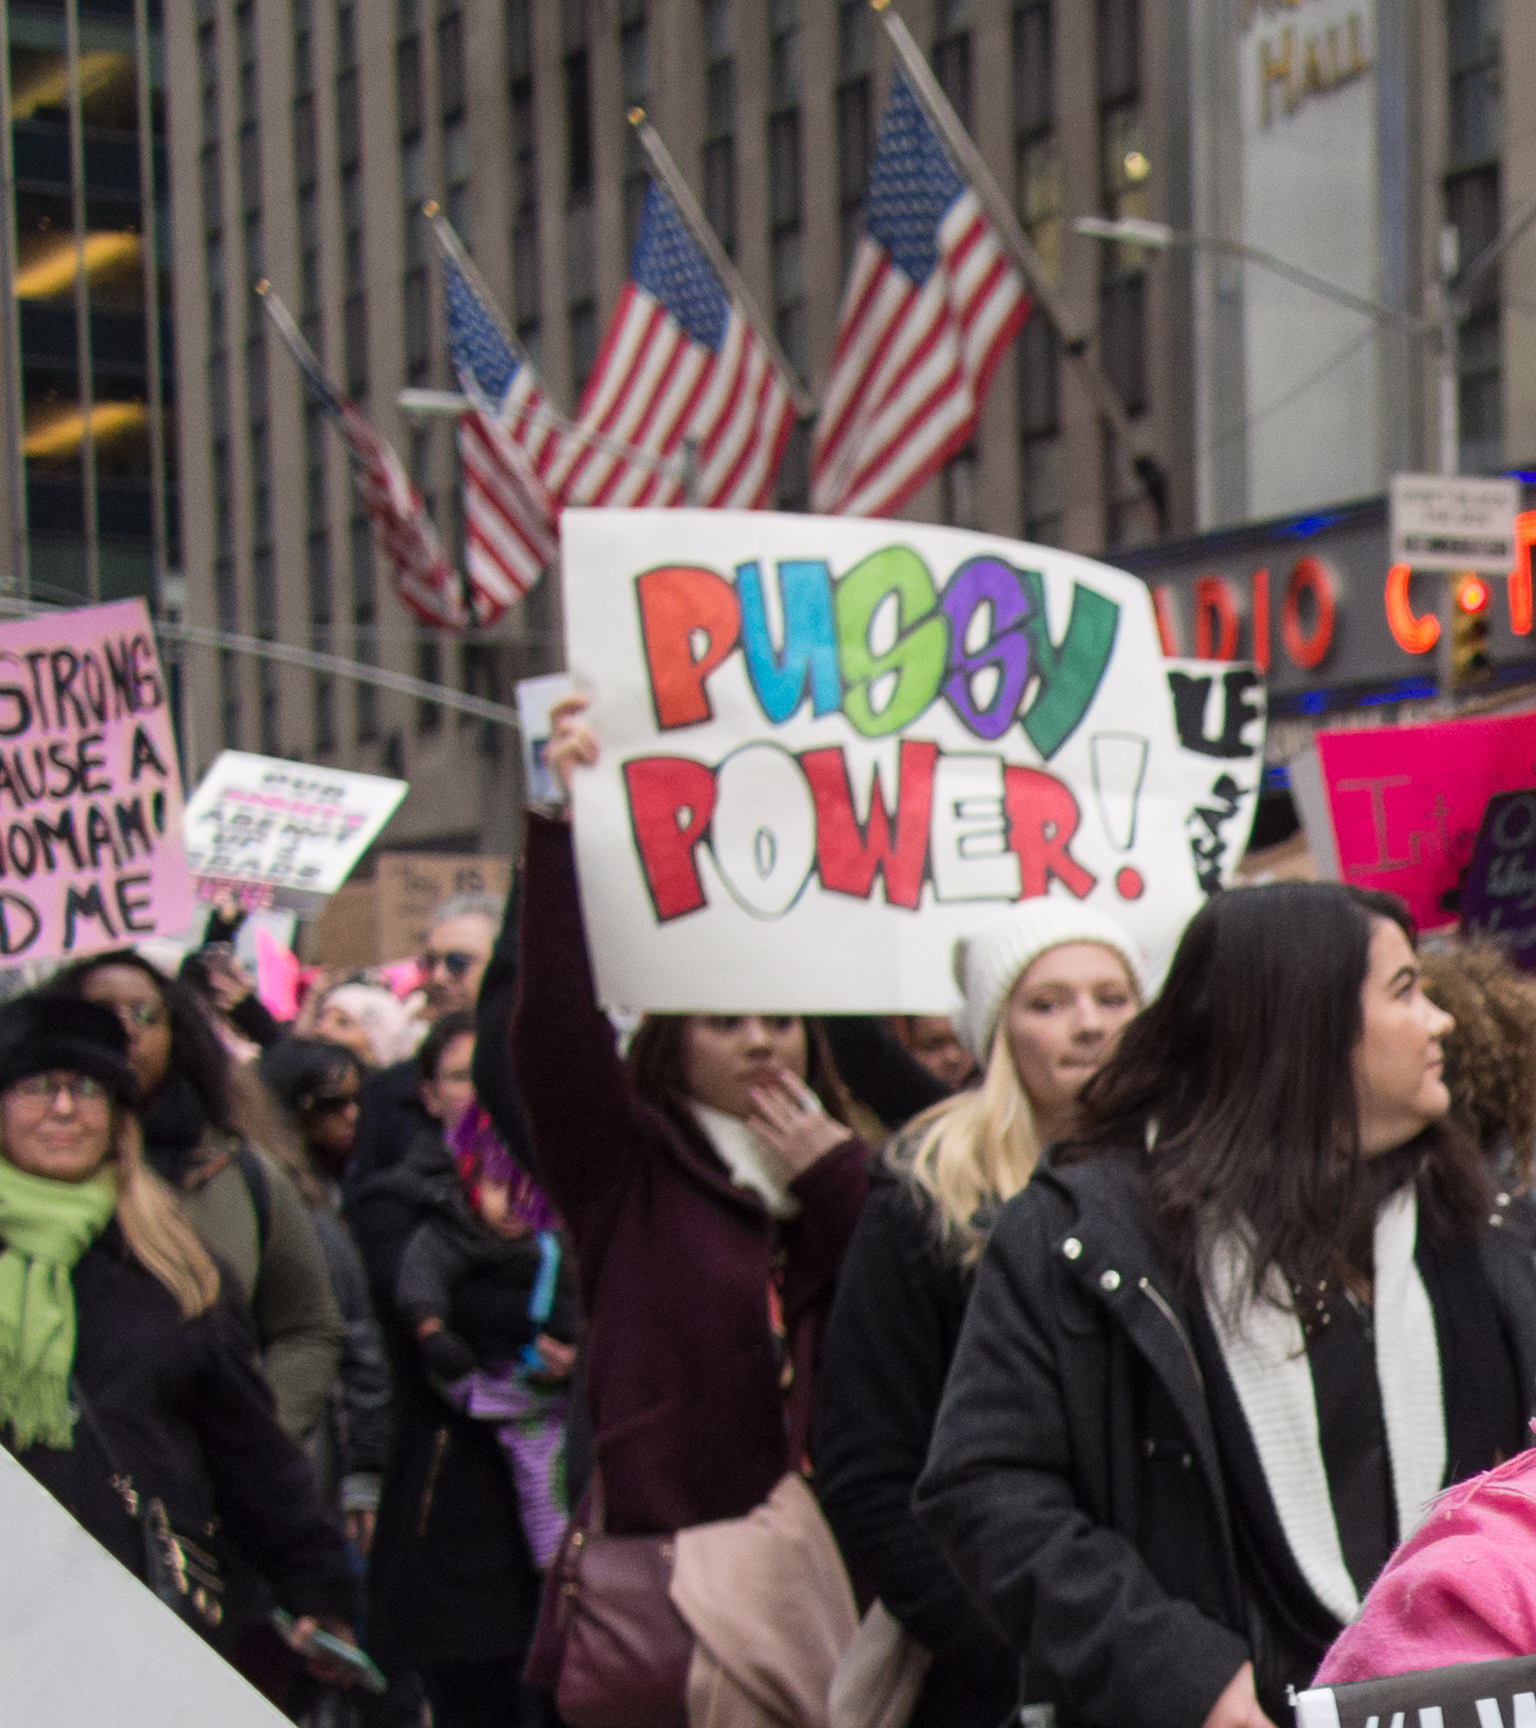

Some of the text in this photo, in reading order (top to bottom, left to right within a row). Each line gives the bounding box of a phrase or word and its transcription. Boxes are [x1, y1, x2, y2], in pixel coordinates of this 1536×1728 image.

[634, 544, 1119, 761] PUSSY
[130, 724, 167, 782] A
[621, 733, 1148, 926] POWER!
[64, 874, 155, 950] ME
